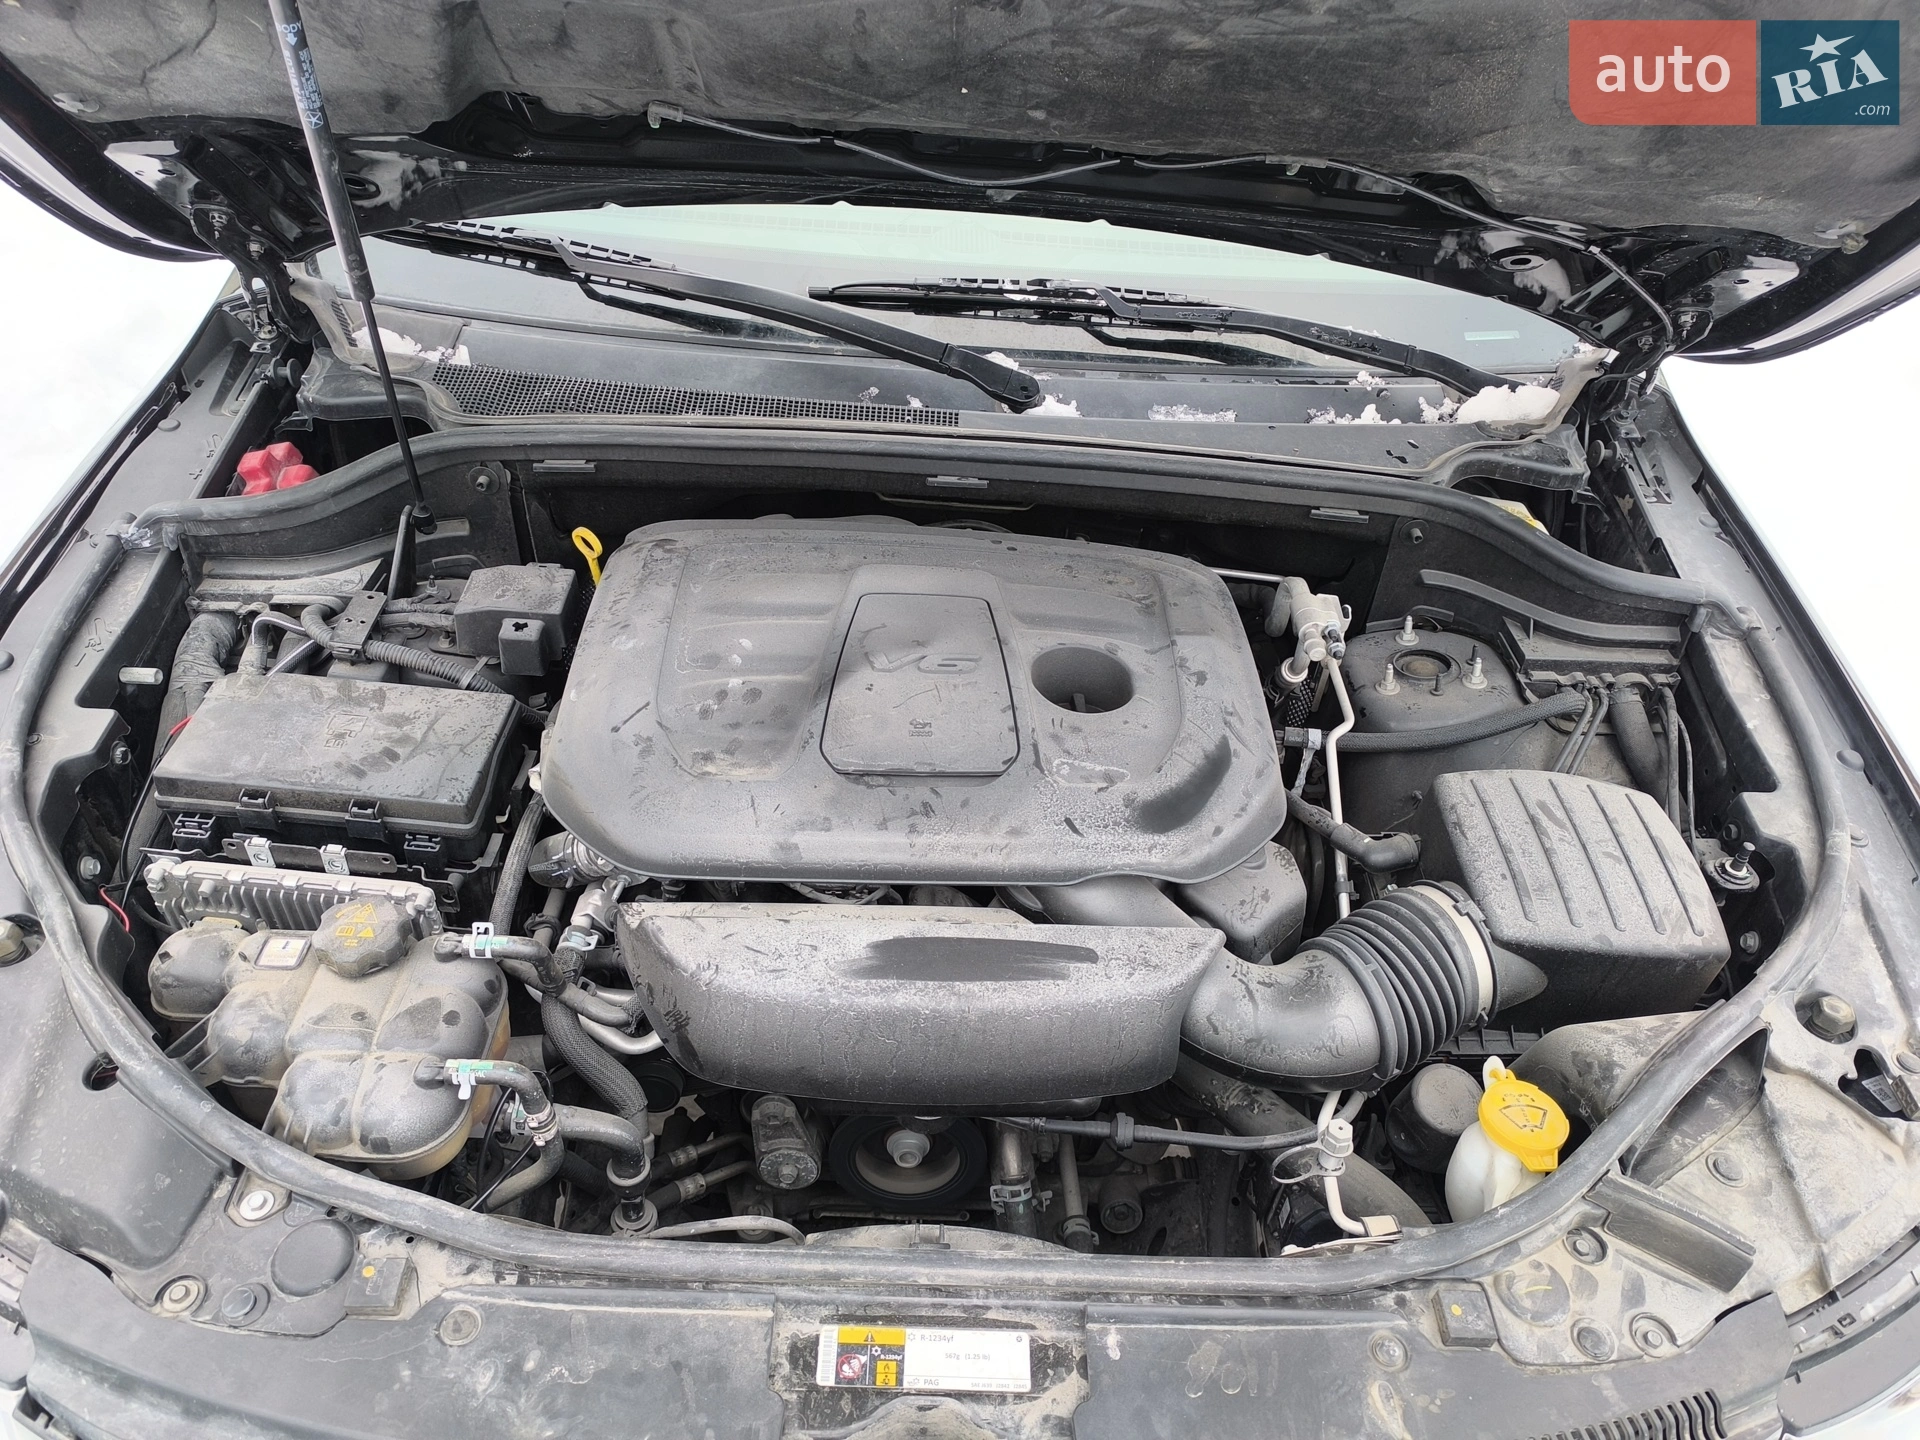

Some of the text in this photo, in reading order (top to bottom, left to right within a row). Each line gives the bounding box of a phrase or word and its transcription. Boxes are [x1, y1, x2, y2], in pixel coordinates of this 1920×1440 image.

[864, 651, 982, 675] V6
[920, 1334, 954, 1343] R-1234yf
[964, 1353, 981, 1361] (1.25
[923, 1378, 940, 1386] PAG
